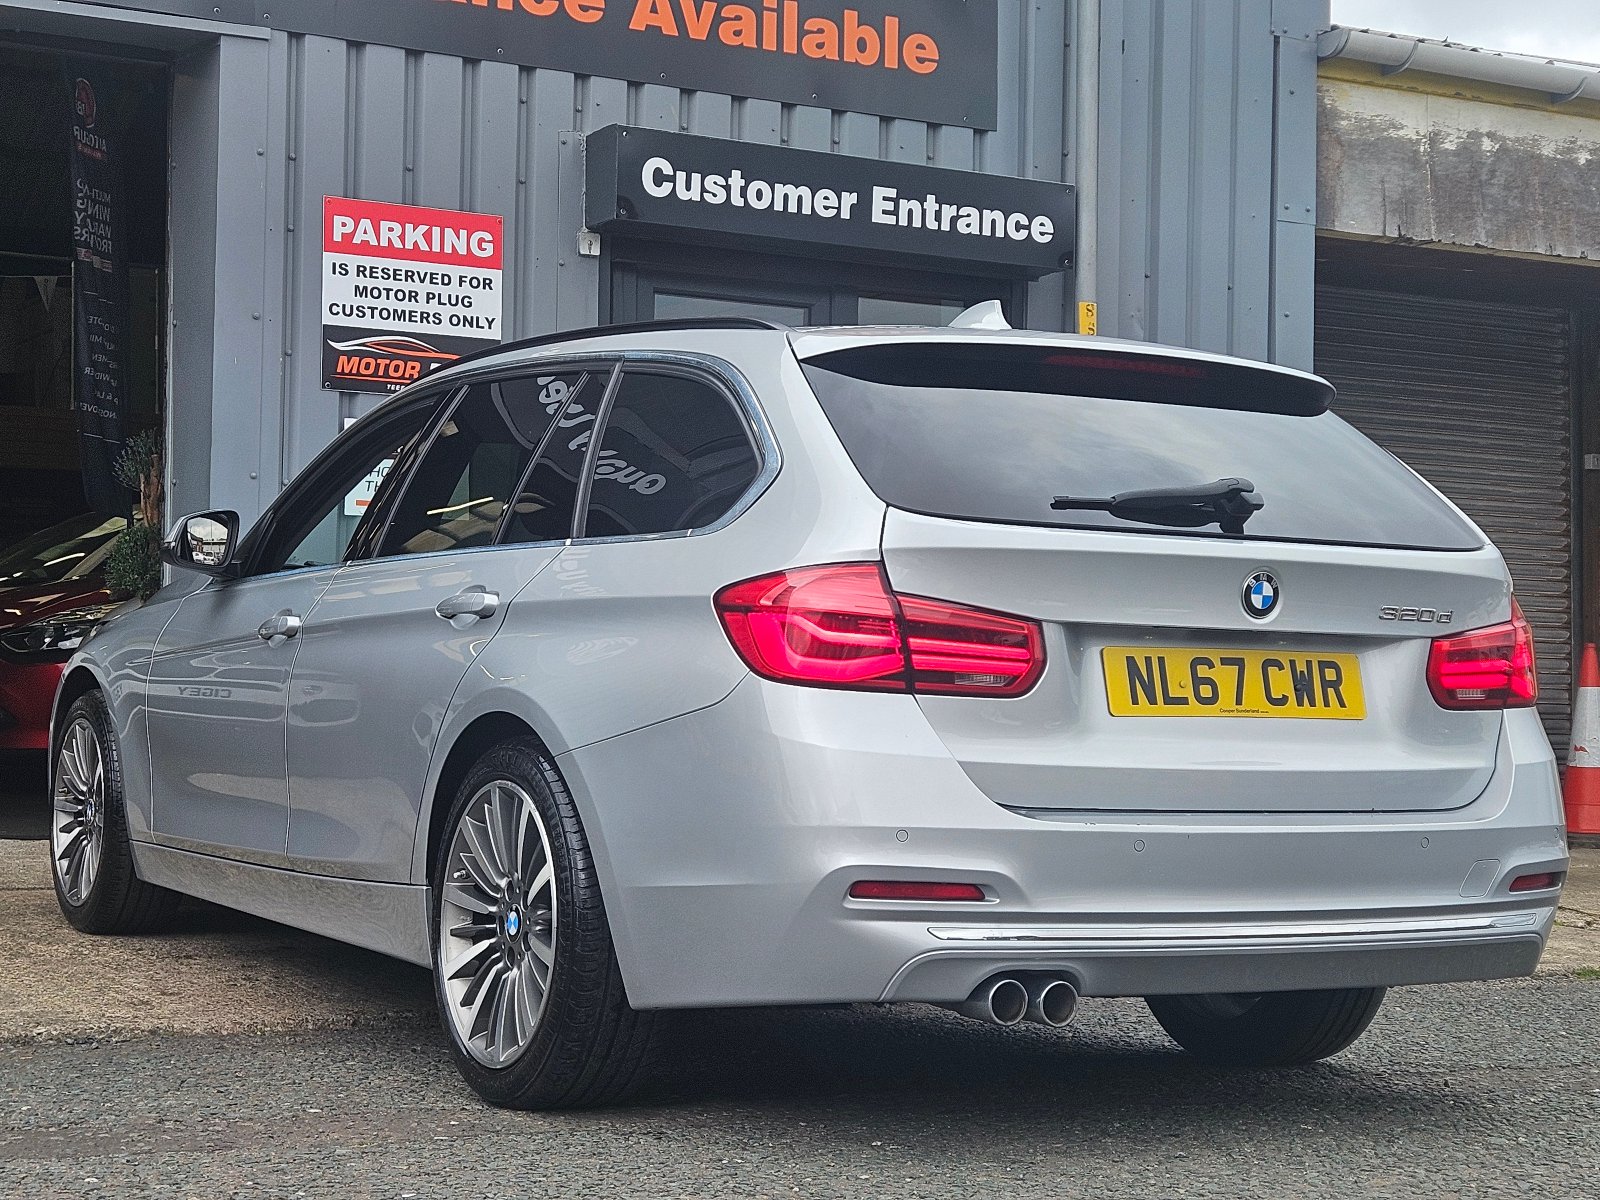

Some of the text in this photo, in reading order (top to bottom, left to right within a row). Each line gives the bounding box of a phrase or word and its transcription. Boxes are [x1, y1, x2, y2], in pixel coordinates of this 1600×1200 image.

[629, 0, 939, 74] Available
[641, 157, 1055, 244] Customer Entrance
[333, 215, 494, 257] PARKING
[331, 262, 493, 290] IS RESERVED FOR
[354, 285, 473, 308] MOTOR PLUG
[328, 303, 496, 330] CUSTOMERS ONLY
[336, 355, 421, 379] MOTOR
[1379, 605, 1454, 623] 320d
[1125, 656, 1347, 708] NL67 CWR
